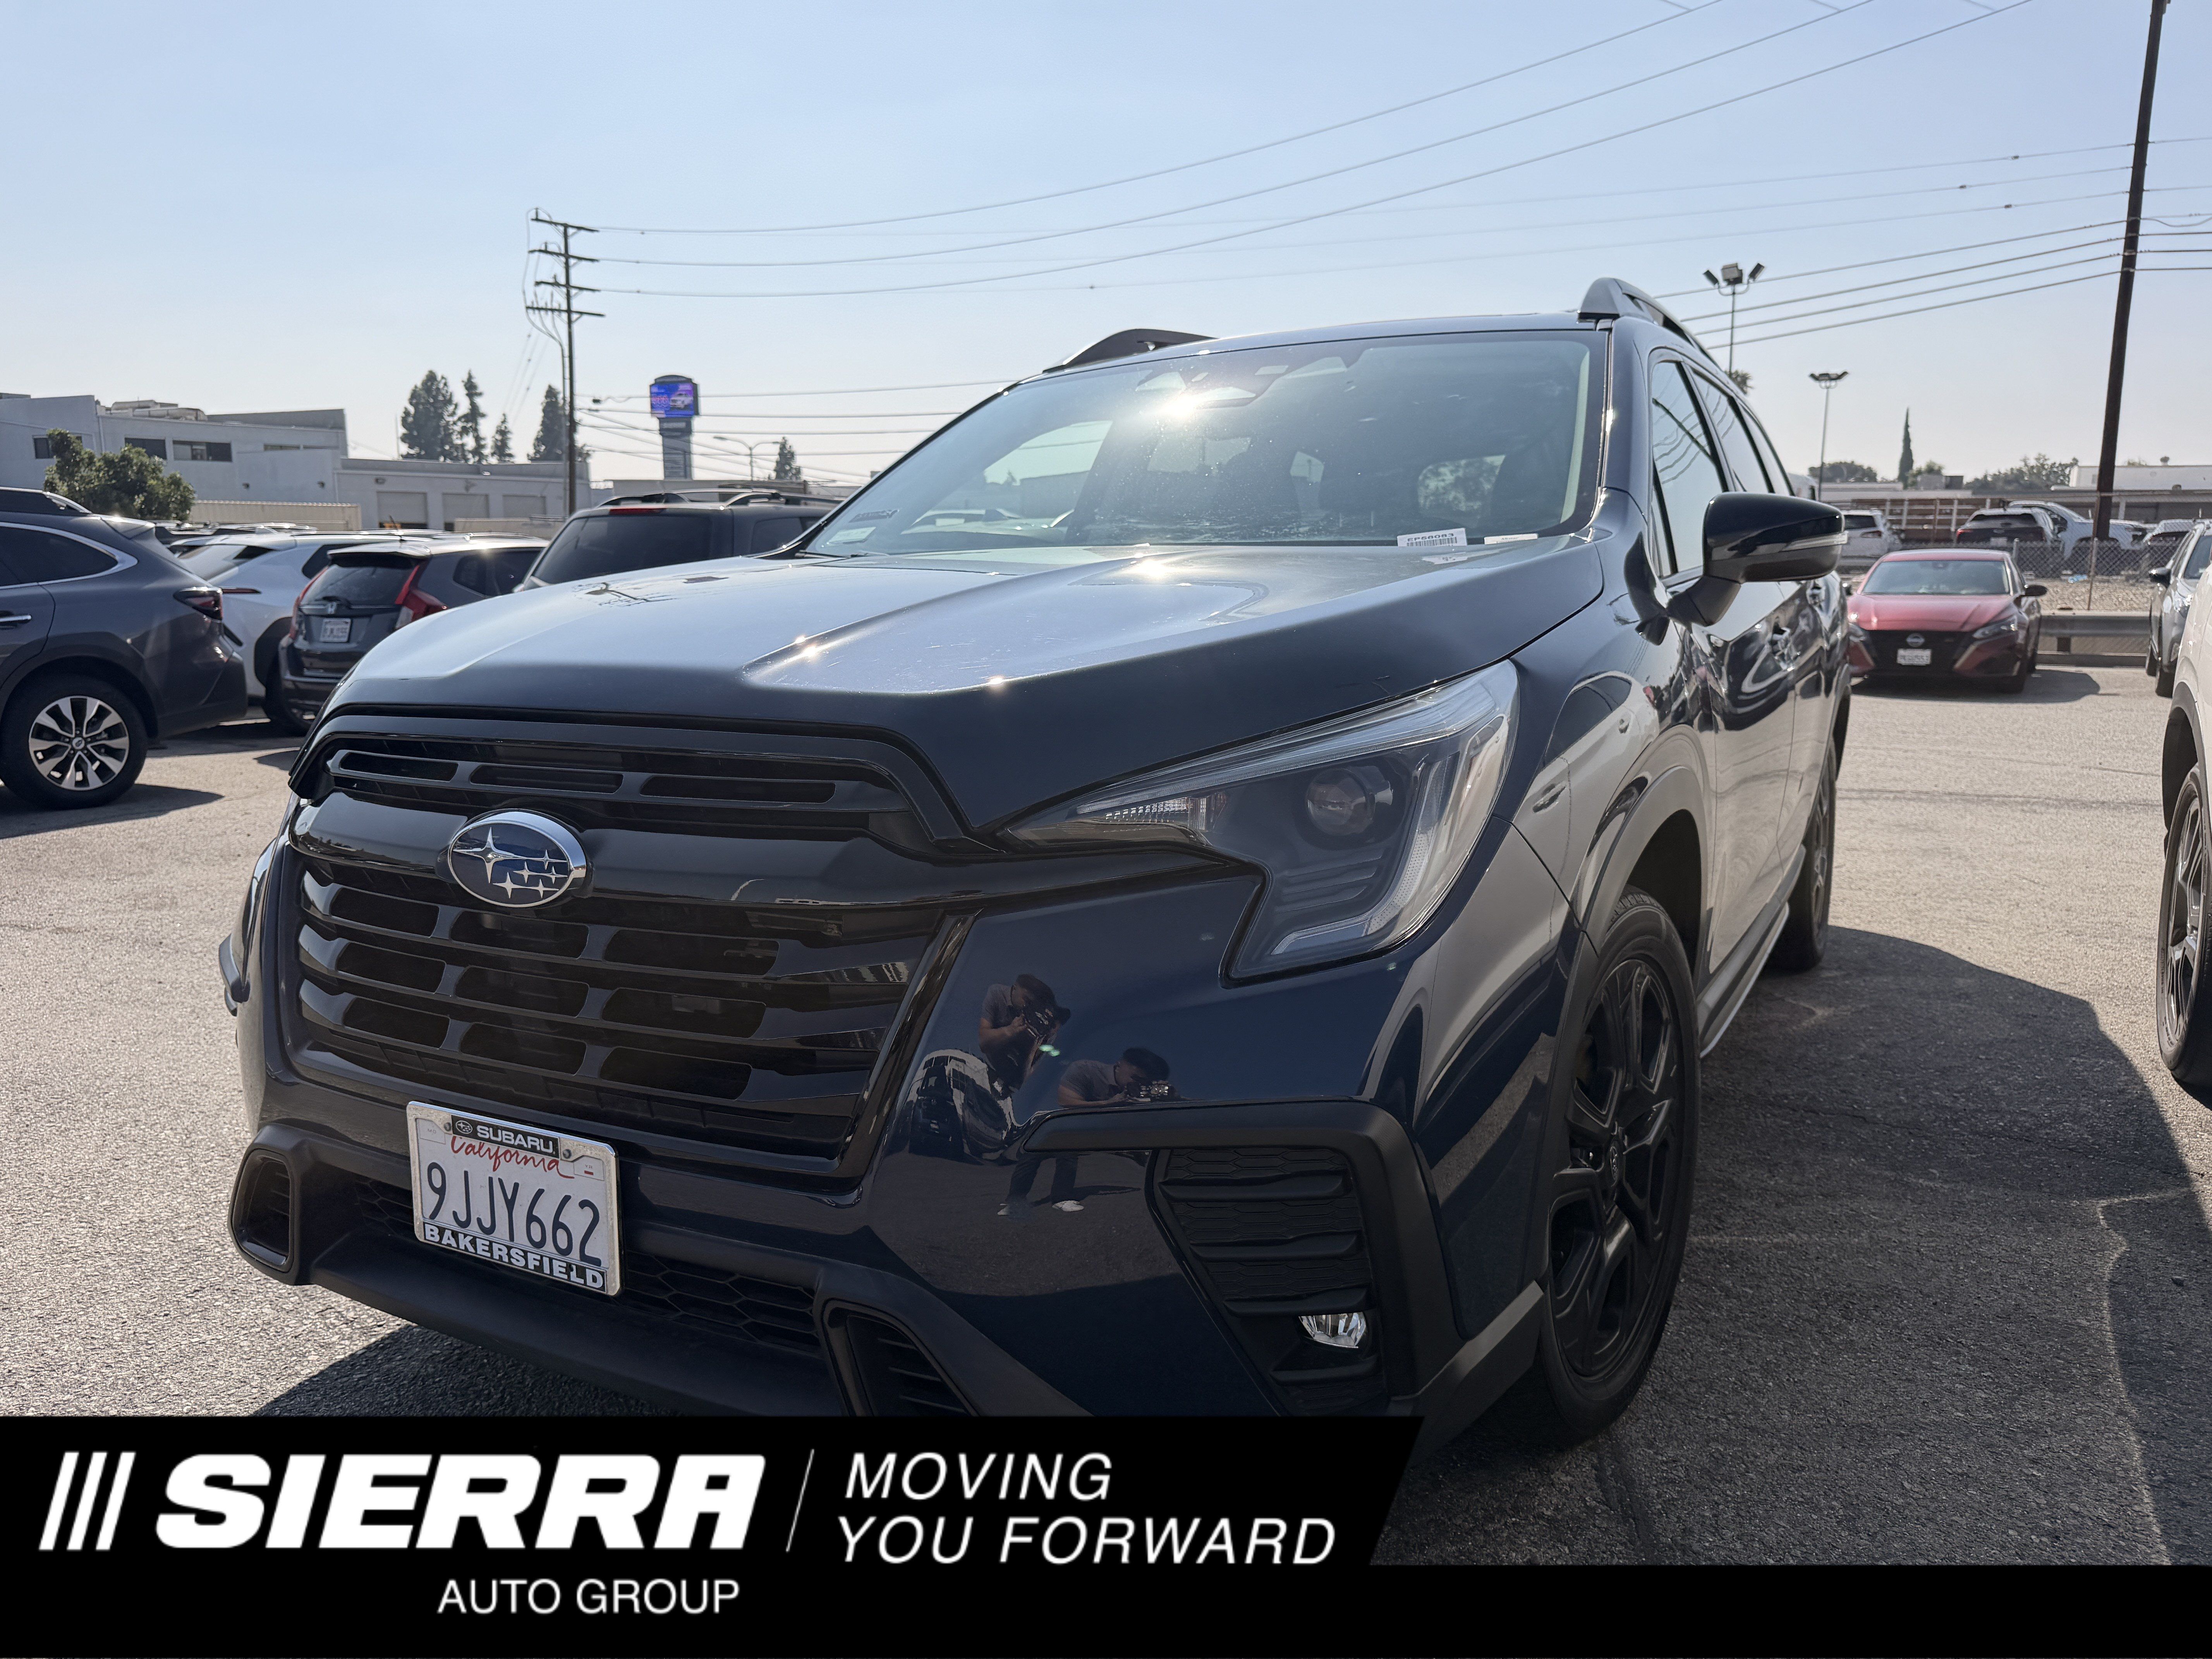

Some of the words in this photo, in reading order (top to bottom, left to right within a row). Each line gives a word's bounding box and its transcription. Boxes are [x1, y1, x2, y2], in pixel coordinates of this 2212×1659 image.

[451, 1135, 575, 1179] California
[476, 1125, 553, 1153] SUBARU
[427, 1162, 602, 1267] 9JJY662
[424, 1223, 603, 1289] BAKERSFIELD
